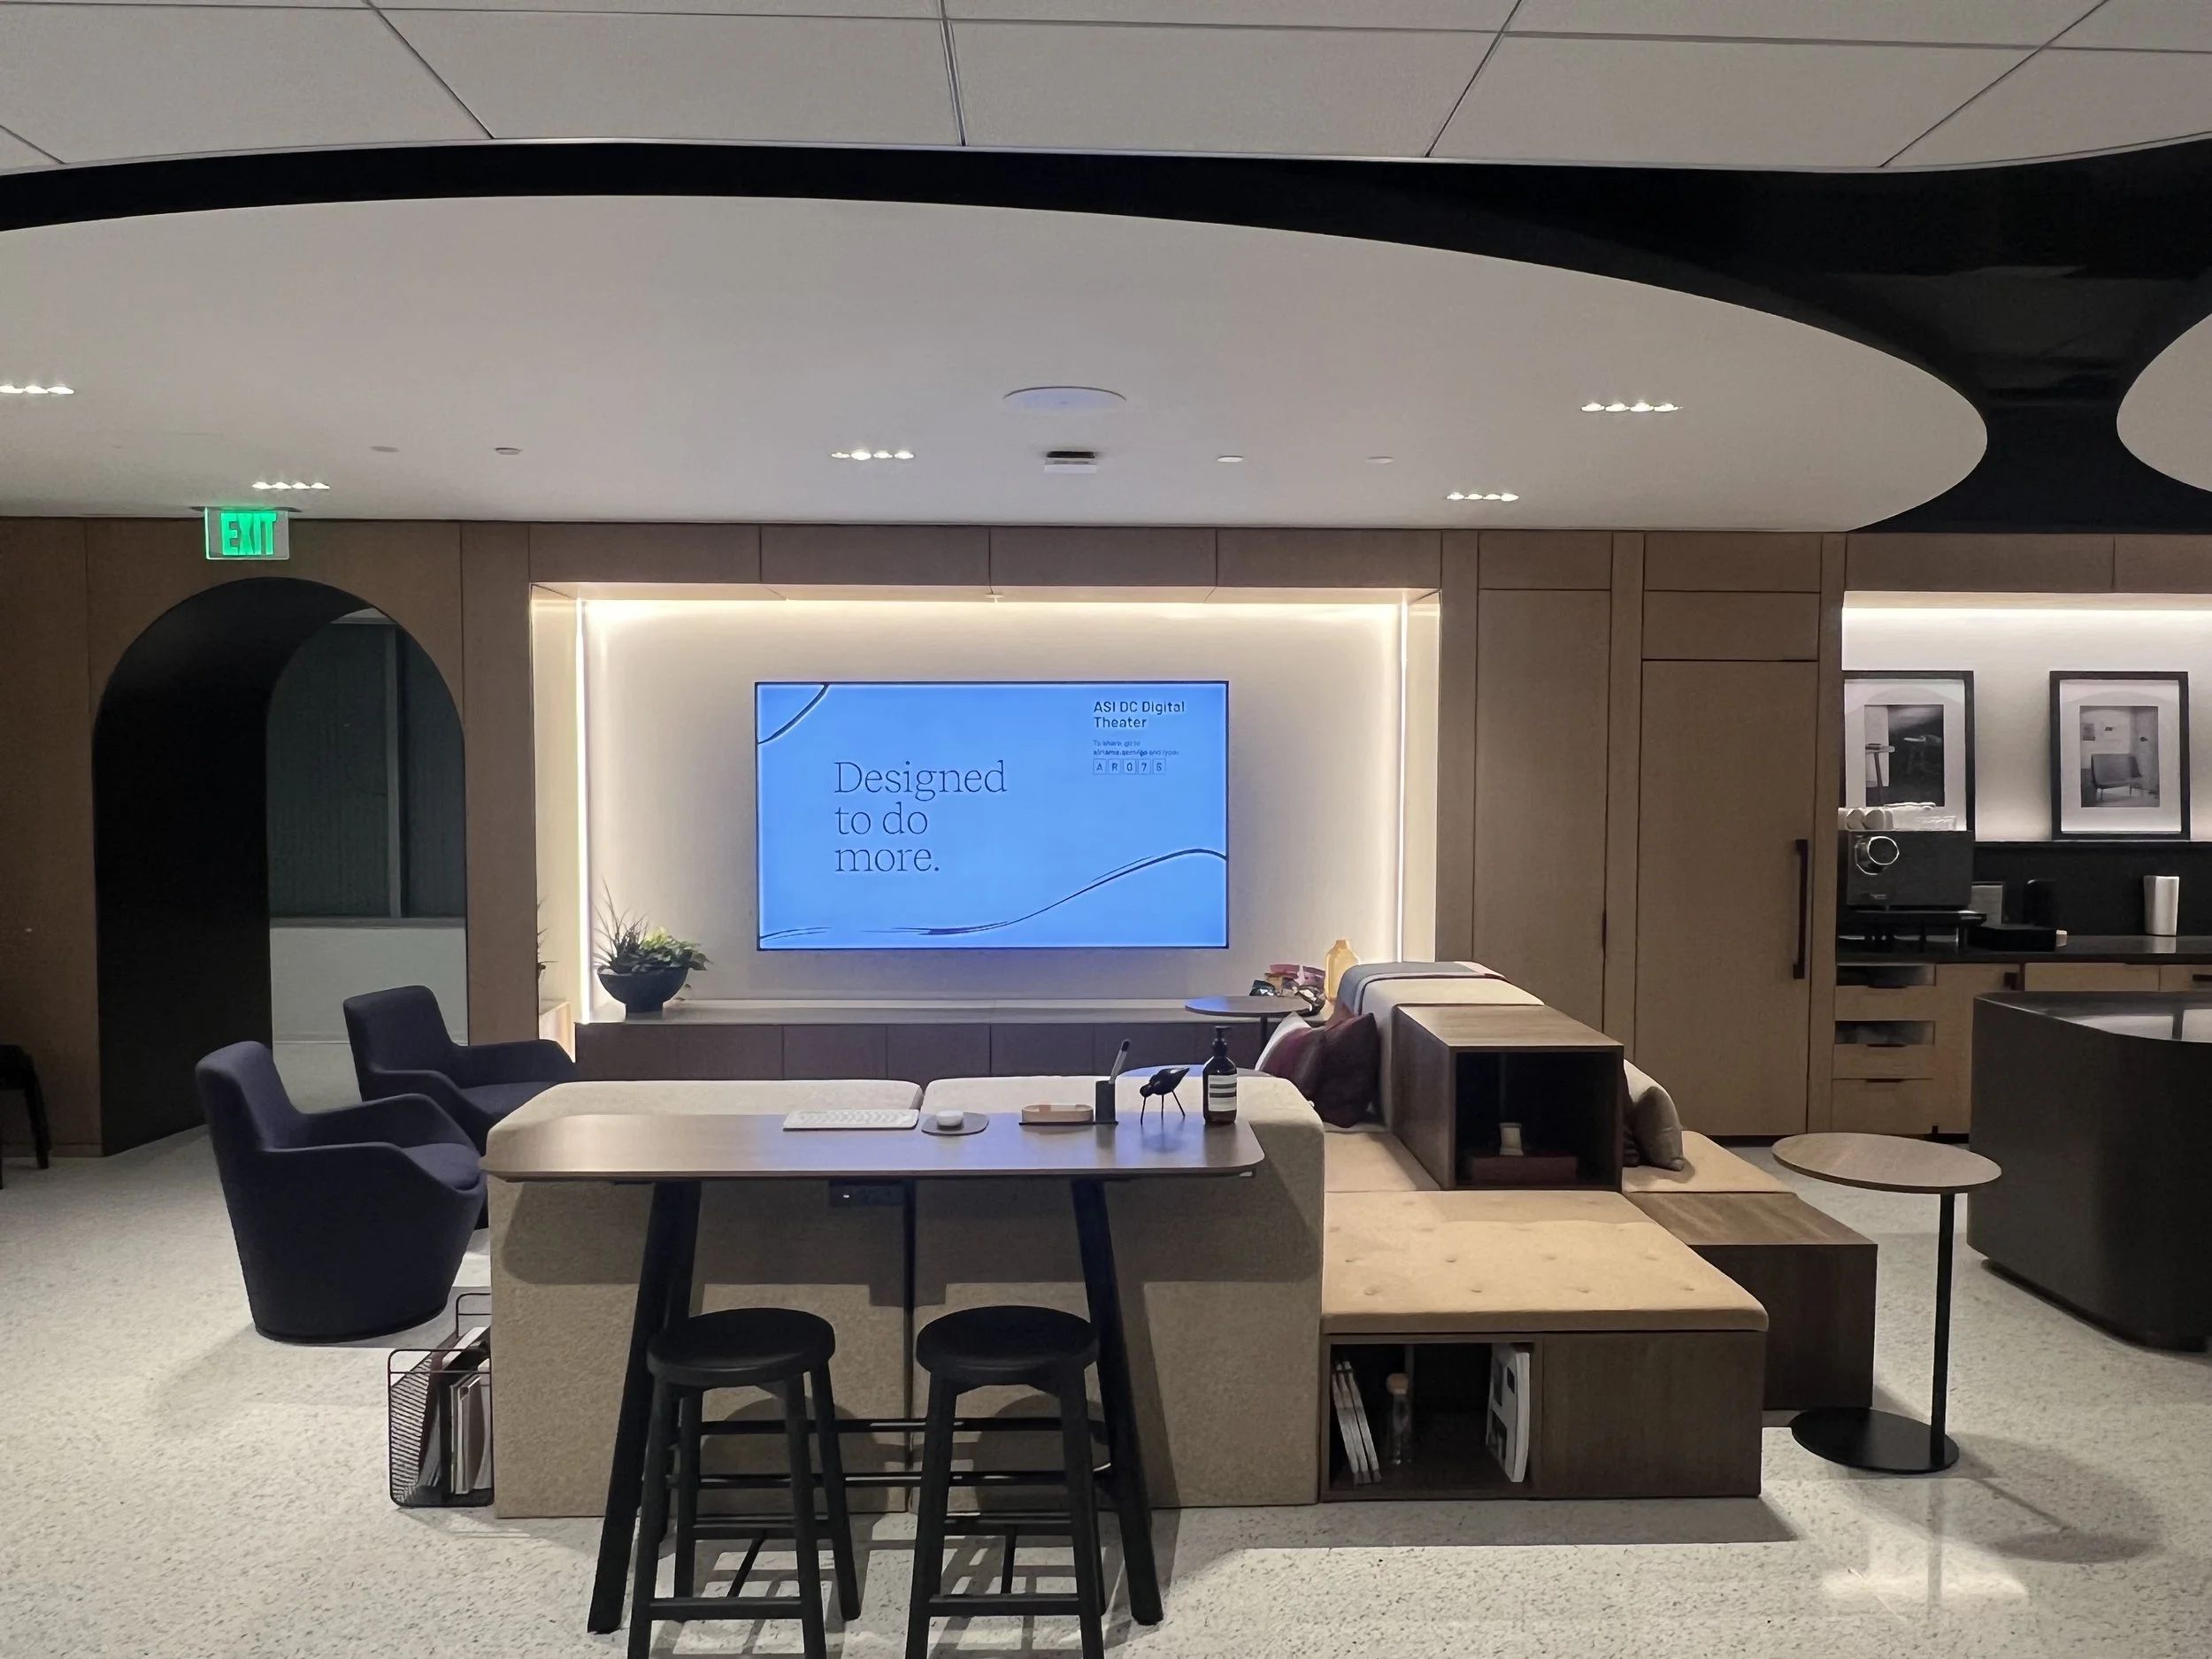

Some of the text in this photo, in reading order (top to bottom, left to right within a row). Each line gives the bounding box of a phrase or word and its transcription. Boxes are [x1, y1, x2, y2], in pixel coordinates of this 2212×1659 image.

[220, 511, 277, 556] EXIT
[1094, 701, 1185, 715] ASI DC Digital
[1094, 717, 1147, 728] Theater
[833, 759, 1008, 802] Designed
[834, 801, 928, 835] to do
[834, 849, 940, 872] more.
